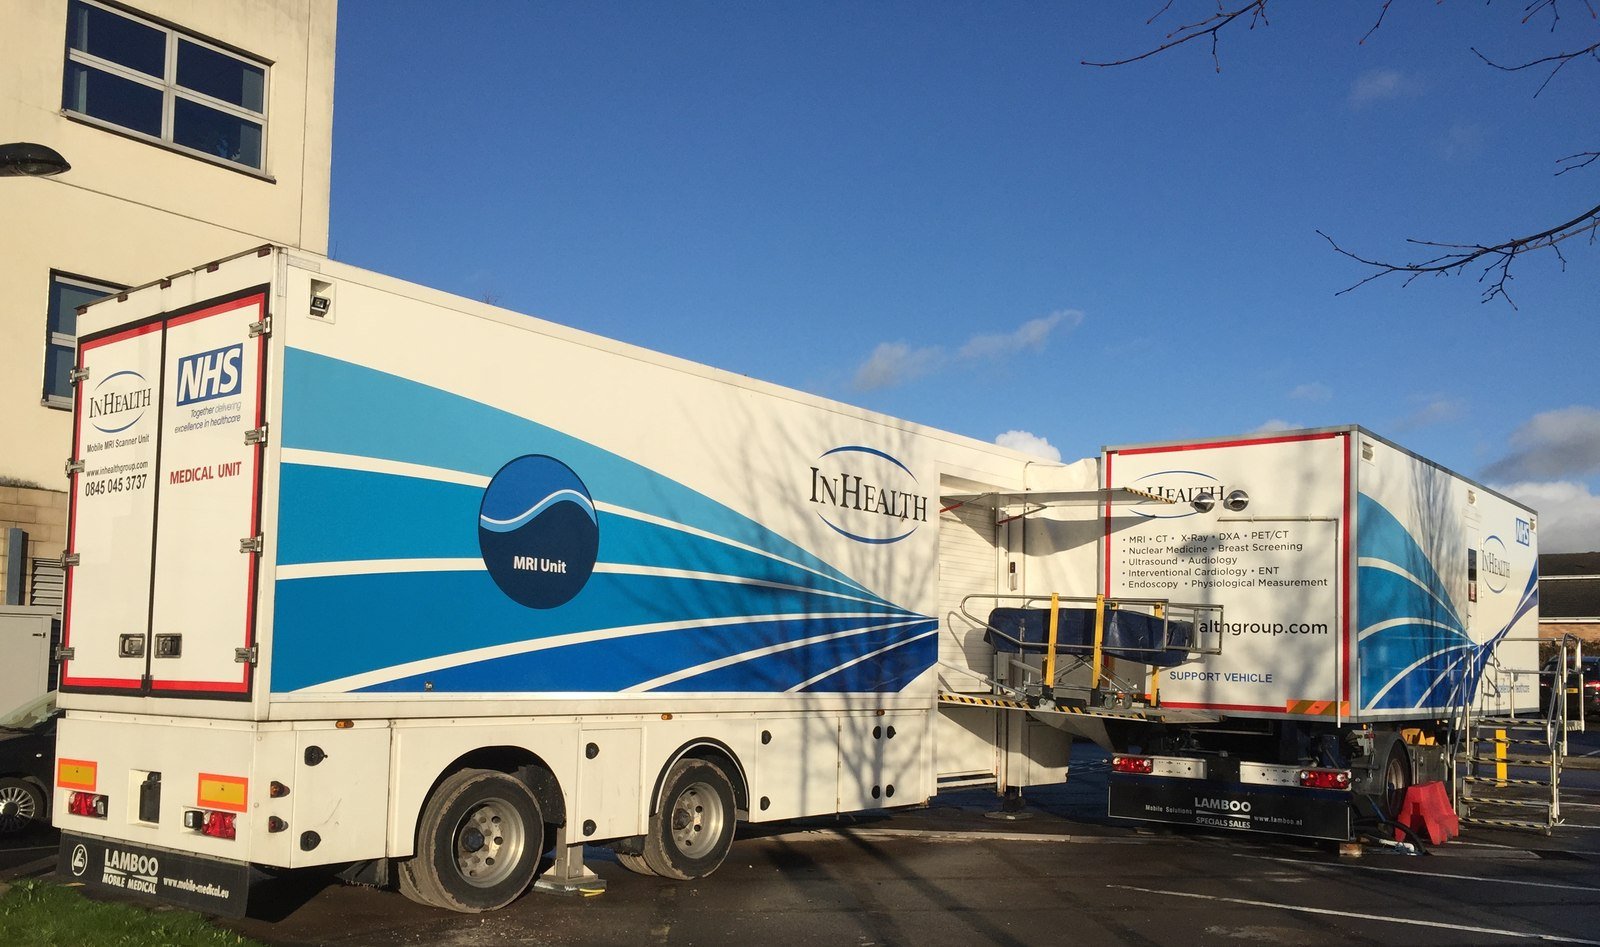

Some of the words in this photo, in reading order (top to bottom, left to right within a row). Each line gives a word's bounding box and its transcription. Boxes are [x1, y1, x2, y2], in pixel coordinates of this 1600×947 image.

[178, 348, 241, 403] NHS
[190, 406, 215, 419] Together
[215, 402, 241, 413] delivering
[175, 421, 203, 434] excellence
[204, 419, 209, 427] in
[210, 415, 241, 426] healthcare
[87, 444, 103, 453] Mobile
[104, 440, 114, 450] MRI
[115, 437, 137, 448] Scanner
[138, 434, 150, 443] Unit
[86, 461, 148, 477] www.inhealthgroup.com
[170, 466, 214, 484] MEDICAL
[218, 462, 242, 477] UNIT
[85, 480, 105, 497] 0845
[107, 477, 123, 494] 045
[125, 474, 147, 491] 3737
[1129, 535, 1145, 543] MRI
[1181, 534, 1208, 543] X-Ray
[1251, 531, 1289, 540] PET/CT
[1517, 519, 1529, 545] NHS
[1166, 546, 1207, 554] Medicine
[1218, 544, 1249, 552] Breast
[1252, 543, 1303, 552] Screening
[513, 555, 538, 571] MRI
[541, 557, 566, 574] Unit
[1128, 558, 1178, 566] Ultrasound
[1188, 556, 1237, 566] Audiology
[1129, 568, 1191, 577] Interventional
[1194, 567, 1247, 576] Cardiology
[1258, 567, 1279, 575] ENT
[1128, 580, 1178, 589] Endoscopy
[1191, 579, 1255, 588] Physiological
[1258, 579, 1327, 587] Measurement
[1169, 671, 1220, 682] SUPPORT
[1224, 673, 1273, 683] VEHICLE
[1145, 804, 1163, 813] Mobile
[1165, 806, 1192, 815] Solutions
[1195, 797, 1251, 813] LAMBOO
[1195, 816, 1227, 827] SPECIALS
[1228, 820, 1251, 829] SALES
[104, 848, 159, 876] LAMBOO
[102, 873, 125, 887] MOBILE
[127, 878, 157, 894] MEDICAL
[163, 877, 229, 899] www.mobile-medical.eu
